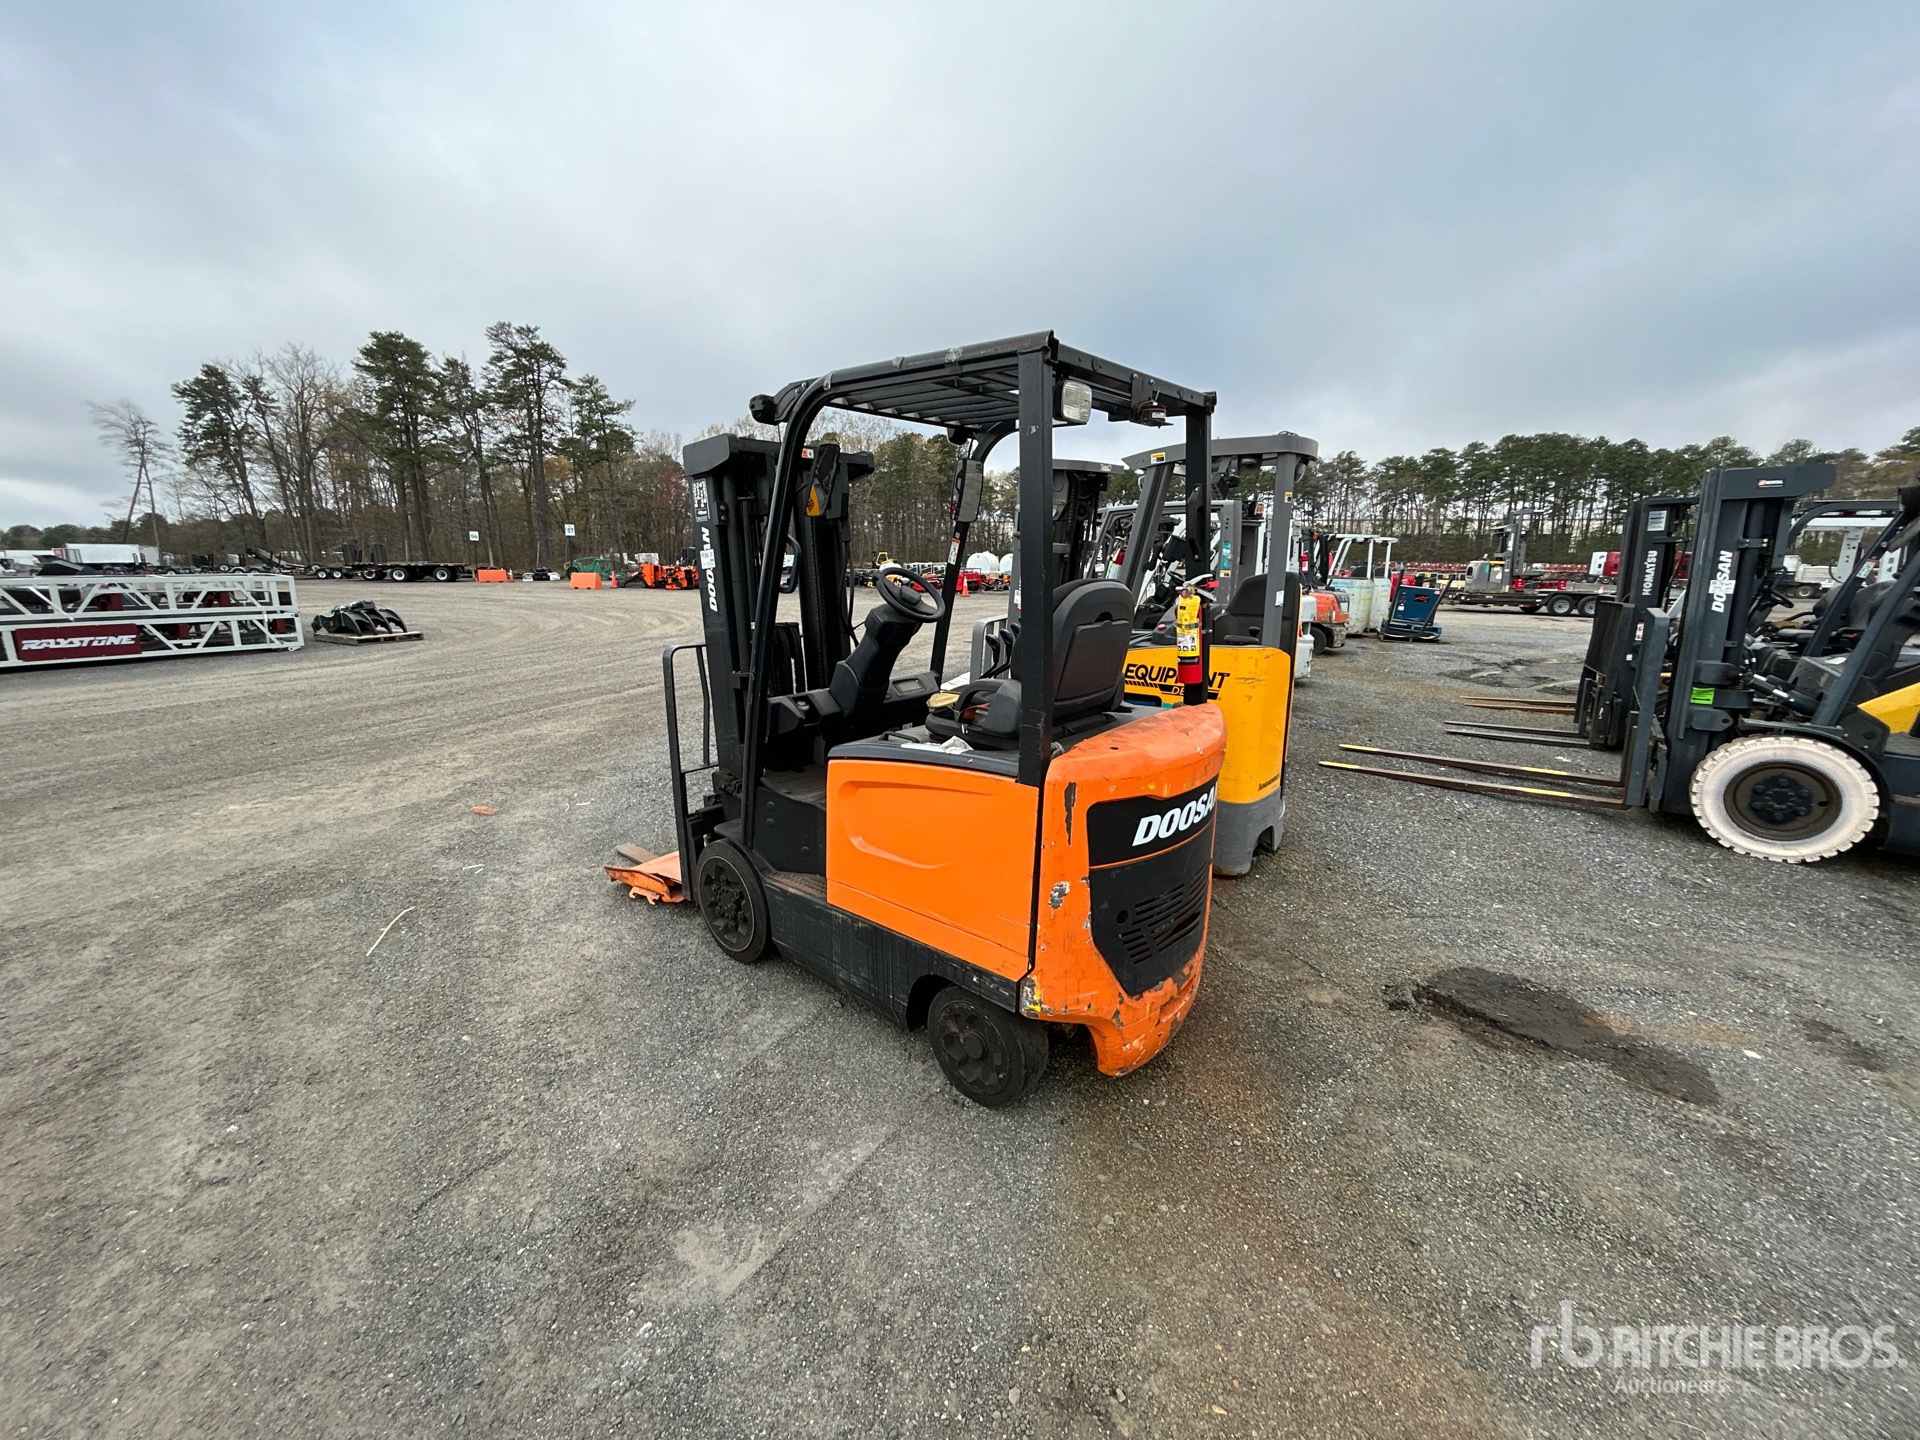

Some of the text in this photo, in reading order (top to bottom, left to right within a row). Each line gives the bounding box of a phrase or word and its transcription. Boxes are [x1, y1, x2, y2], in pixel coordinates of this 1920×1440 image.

[1642, 550, 1658, 596] KOMATSU
[1711, 550, 1733, 613] DOSAN
[22, 634, 137, 650] RAYSTONE
[1125, 663, 1230, 689] EQUIPNT
[1131, 786, 1216, 847] DOOSA
